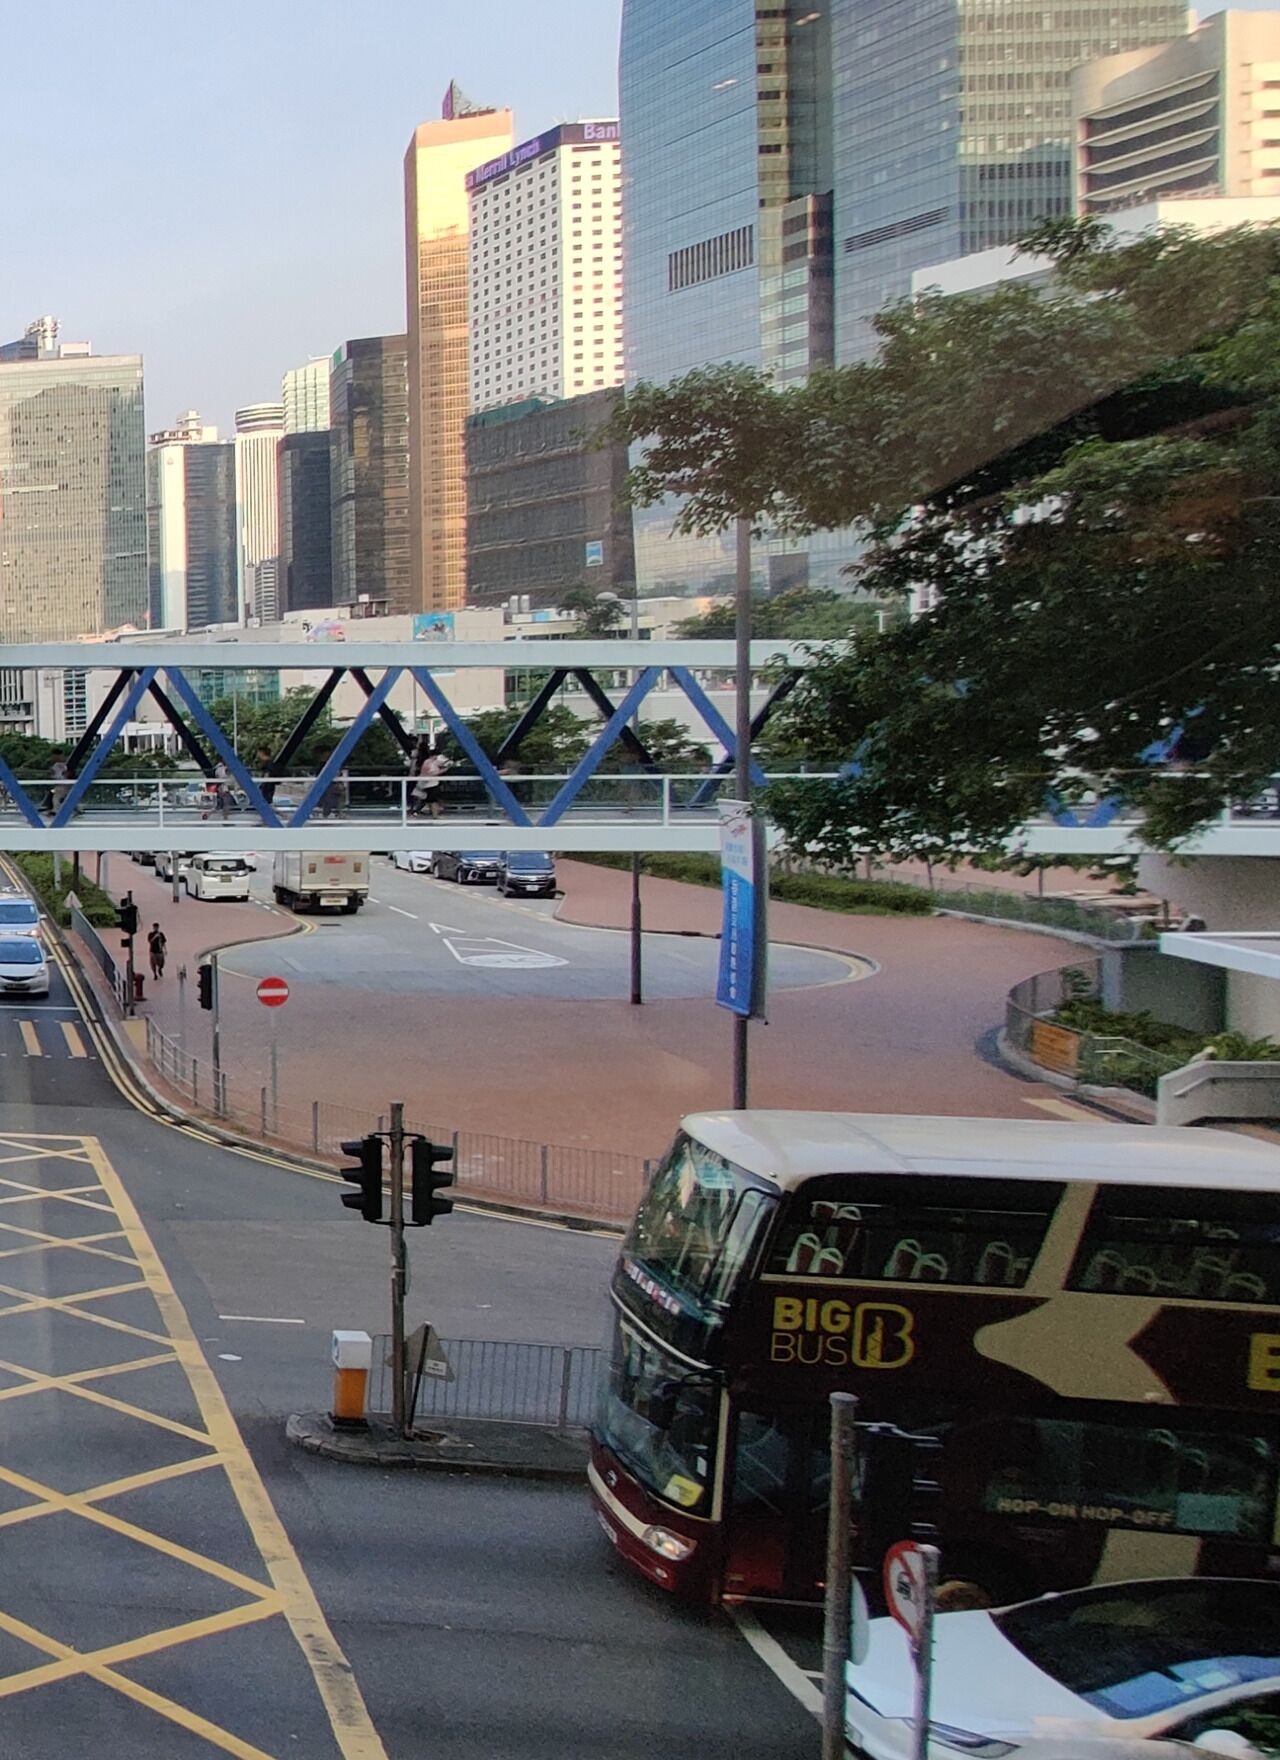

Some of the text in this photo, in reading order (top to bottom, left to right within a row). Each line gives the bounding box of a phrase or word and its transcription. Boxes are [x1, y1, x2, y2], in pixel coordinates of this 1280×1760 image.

[475, 157, 507, 184] Merrill
[509, 141, 540, 167] Lynch
[773, 1296, 852, 1334] BIG
[770, 1331, 848, 1366] BUS
[997, 1497, 1174, 1526] HOP-ON HOP-OFF
